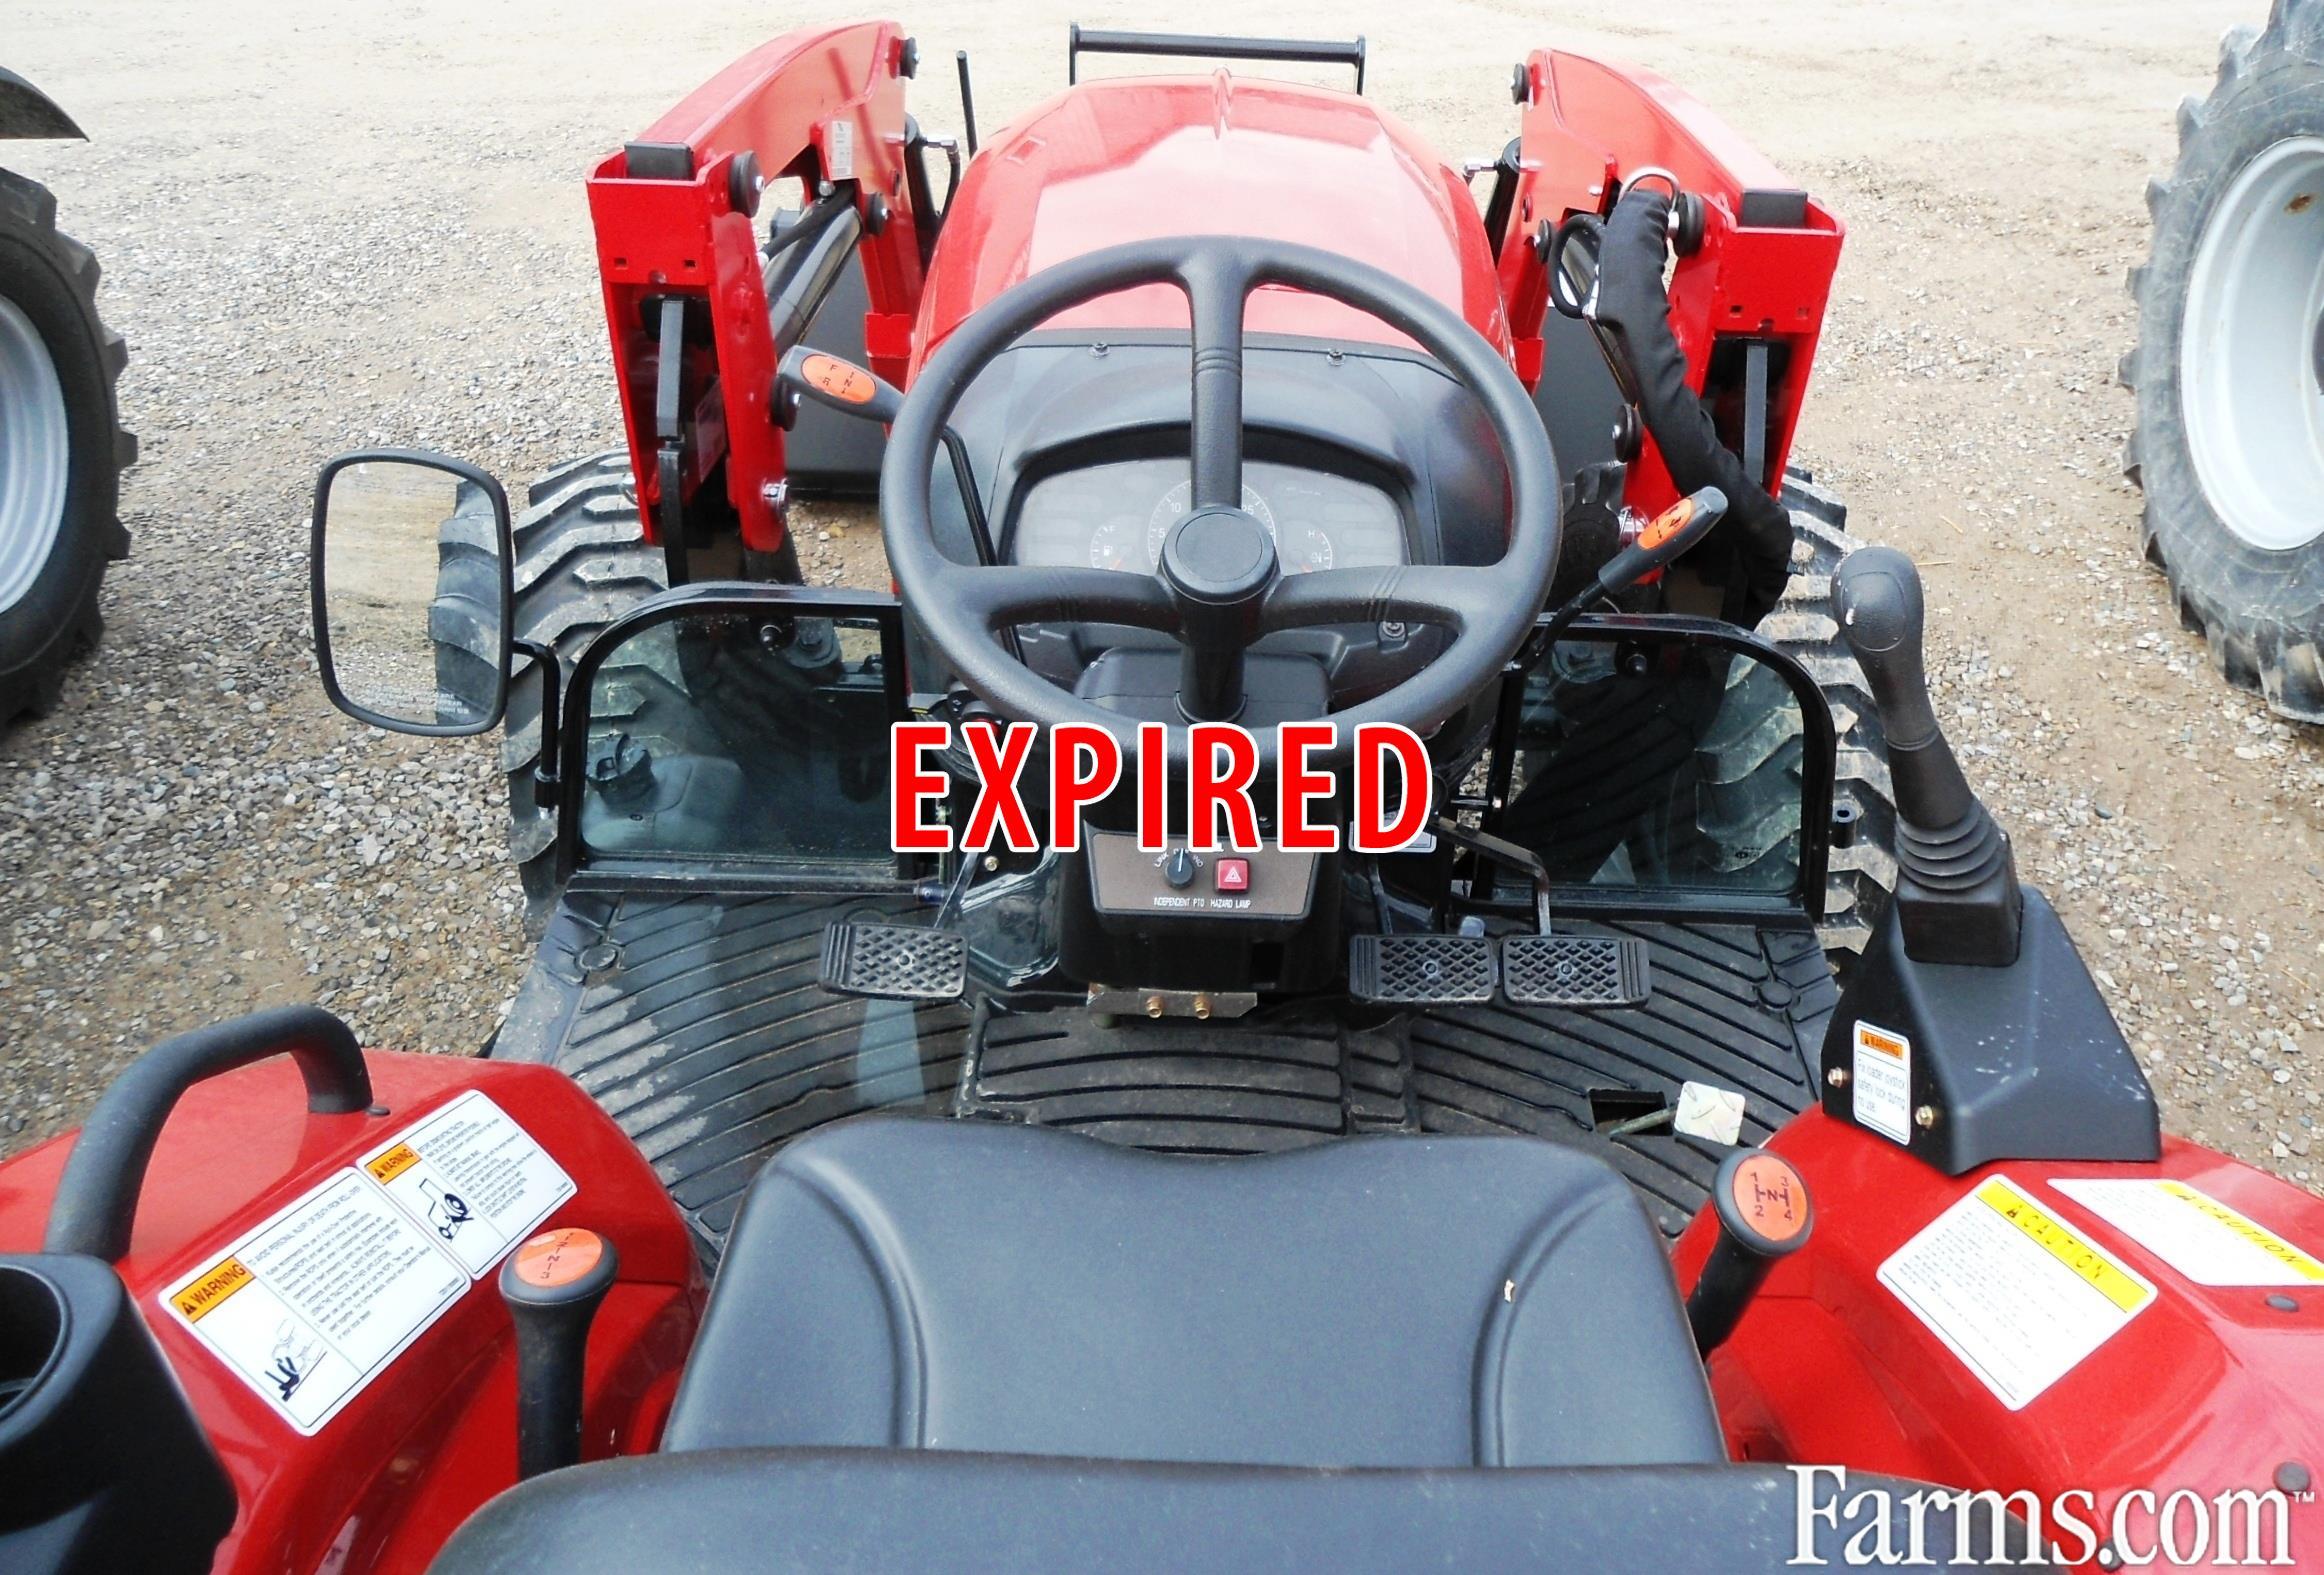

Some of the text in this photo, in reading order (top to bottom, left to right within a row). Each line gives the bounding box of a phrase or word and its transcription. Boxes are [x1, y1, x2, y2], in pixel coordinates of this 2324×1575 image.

[1170, 502, 1182, 513] 10
[1159, 527, 1166, 538] 5
[1154, 896, 1205, 908] INDEPENDENT PTO
[1210, 898, 1251, 909] HAZARD LAMP
[383, 1148, 413, 1172] WARNING
[1767, 1188, 1779, 1202] N
[1754, 1204, 1765, 1217] 2
[2199, 1205, 2303, 1263] CAUTION
[2023, 1215, 2105, 1280] CAUTION
[189, 1263, 247, 1305] WARNING
